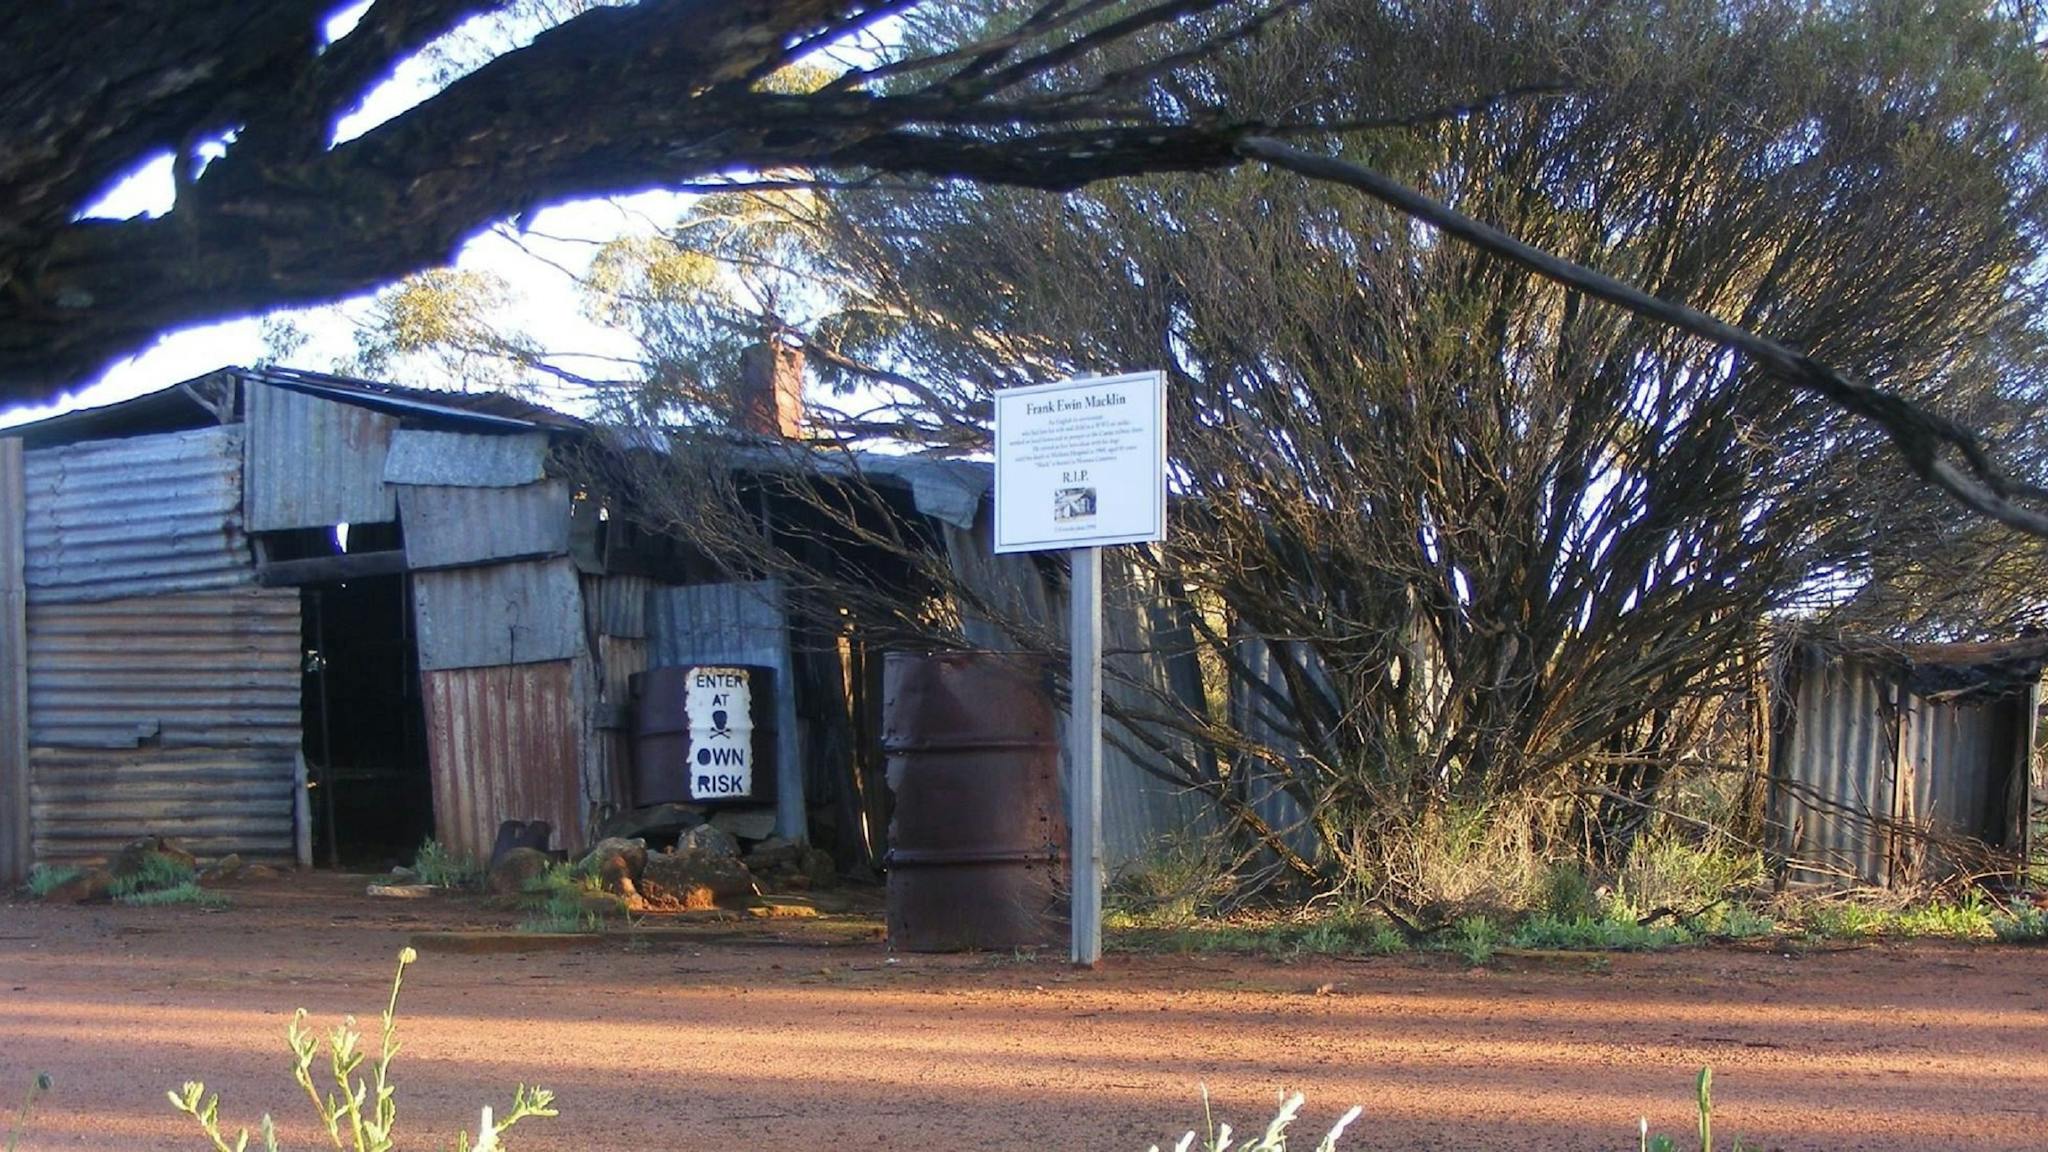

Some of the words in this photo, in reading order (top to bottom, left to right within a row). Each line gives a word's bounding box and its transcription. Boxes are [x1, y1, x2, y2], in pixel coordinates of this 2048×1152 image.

[1027, 403, 1055, 415] Frank
[1057, 399, 1082, 411] Ewin
[1085, 393, 1126, 409] Macklin
[1063, 470, 1089, 483] R.I.P.
[696, 674, 744, 688] ENTER
[712, 694, 730, 706] AT
[697, 748, 744, 766] OWN
[698, 775, 743, 793] RISK
